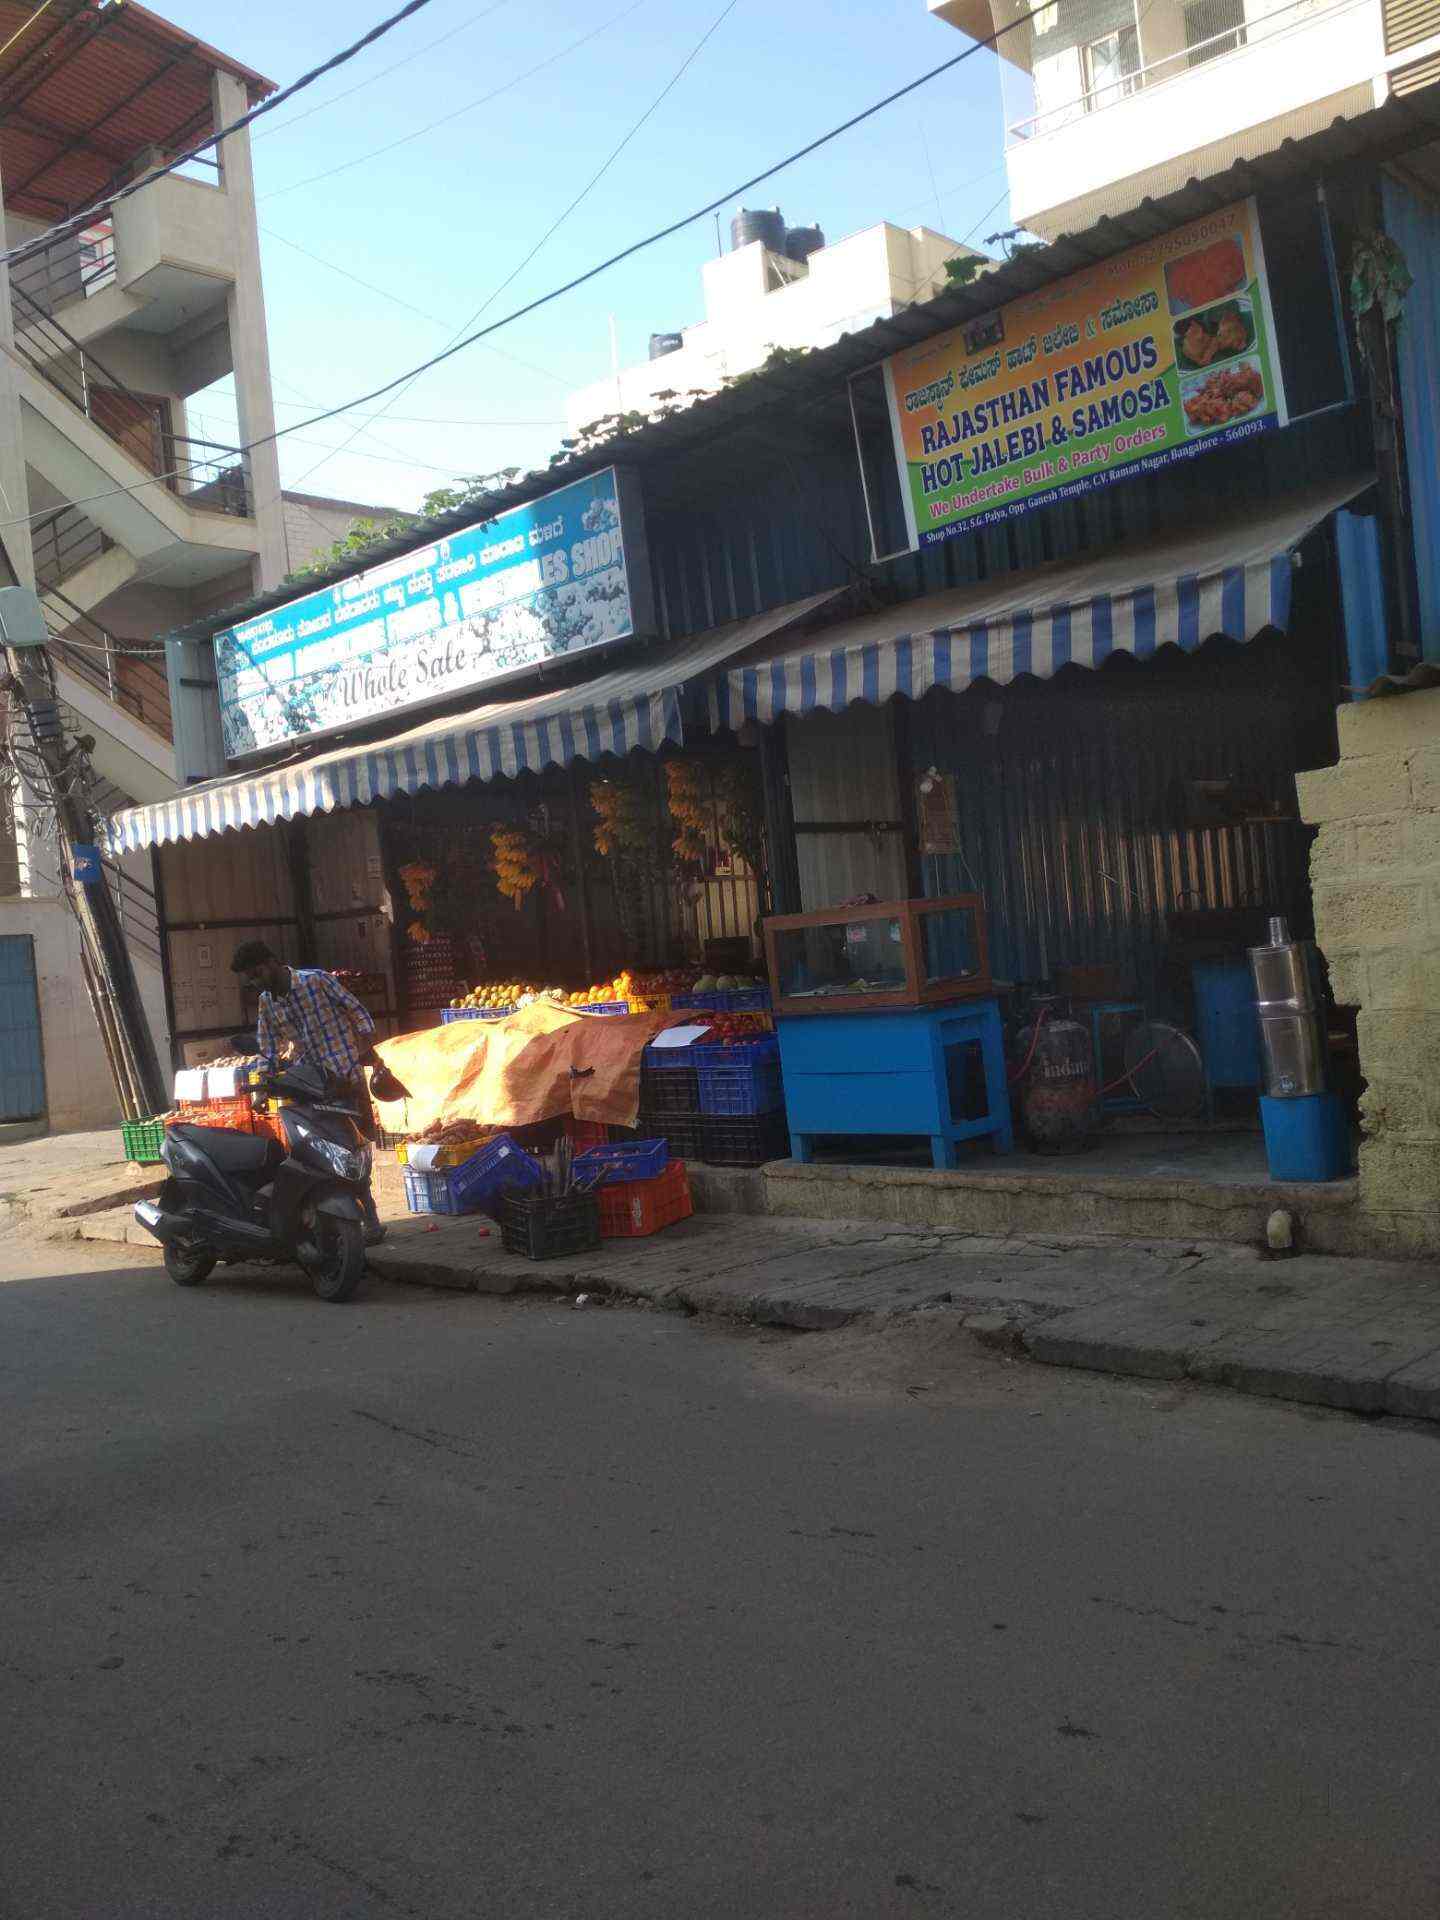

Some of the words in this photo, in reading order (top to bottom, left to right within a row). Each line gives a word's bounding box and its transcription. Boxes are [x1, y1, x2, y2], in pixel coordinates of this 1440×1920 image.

[920, 377, 1051, 455] RAJASTHAN
[1054, 334, 1158, 403] FAMOUS
[920, 451, 966, 493] HOT
[968, 421, 1046, 476] JALEBI
[1048, 412, 1068, 447] &
[1071, 377, 1170, 439] SAMOSA
[928, 496, 950, 518] We
[951, 473, 1021, 511] Undertake
[1022, 459, 1054, 485] Bulk
[1056, 454, 1068, 473] &
[1072, 443, 1111, 468] Party
[1114, 423, 1166, 454] Orders
[1028, 489, 1058, 508] Ganesh
[1170, 435, 1219, 461] Bangalore
[338, 657, 407, 707] Whole
[416, 639, 466, 683] Sale
